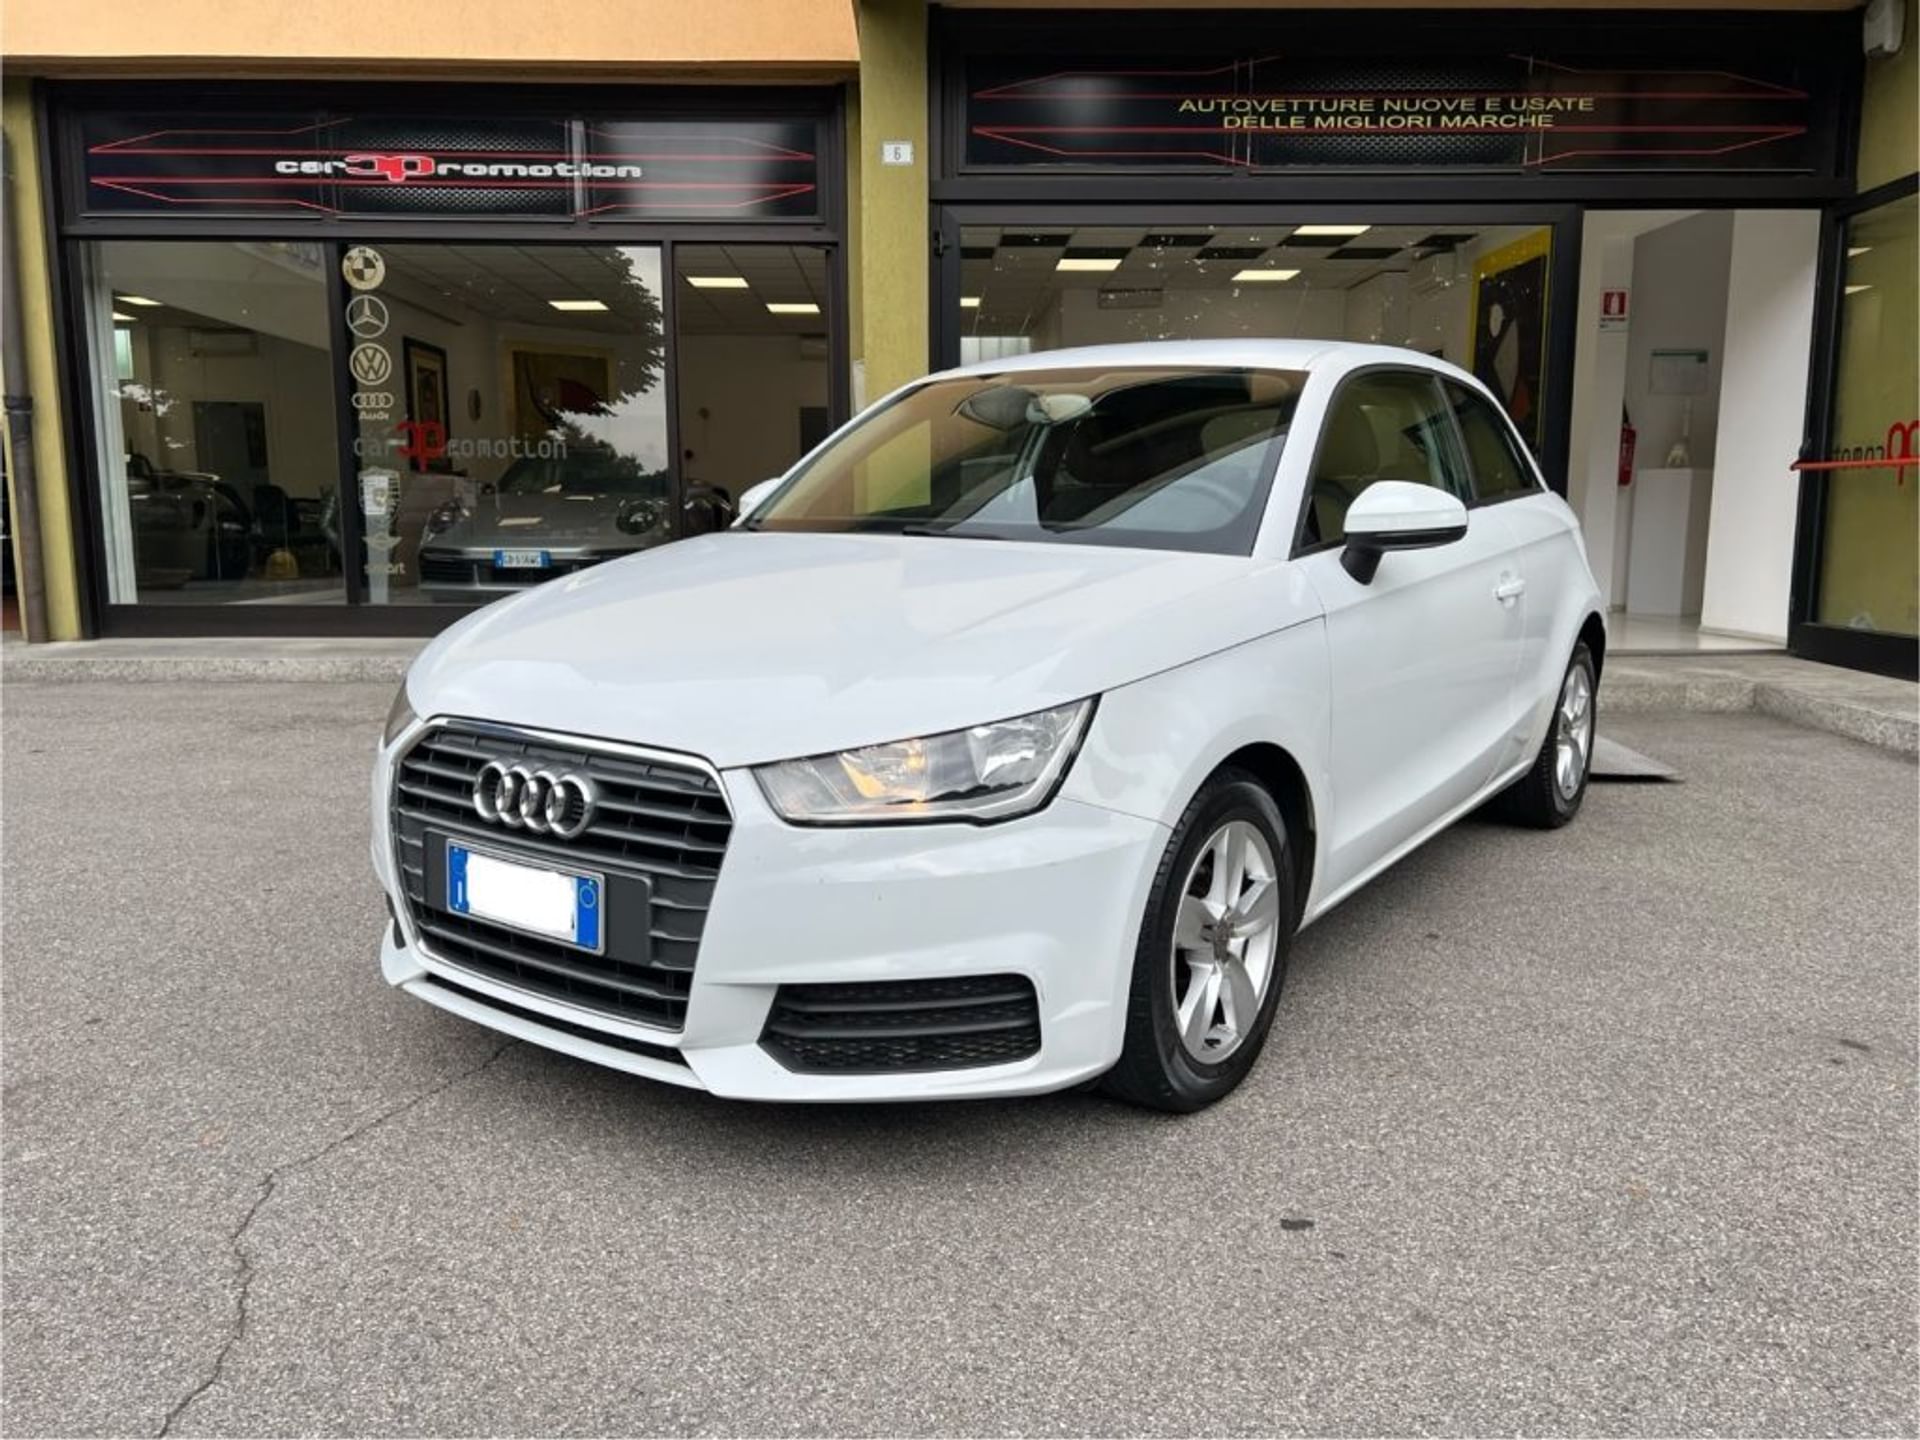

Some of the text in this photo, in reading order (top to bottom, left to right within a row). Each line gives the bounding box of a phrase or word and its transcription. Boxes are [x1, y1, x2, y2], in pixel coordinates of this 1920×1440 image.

[1179, 97, 1594, 112] AUTOVETTURE NUOVE E USATE
[1223, 114, 1554, 129] DELLE MIGLIORI MARCHE
[894, 146, 901, 161] 6
